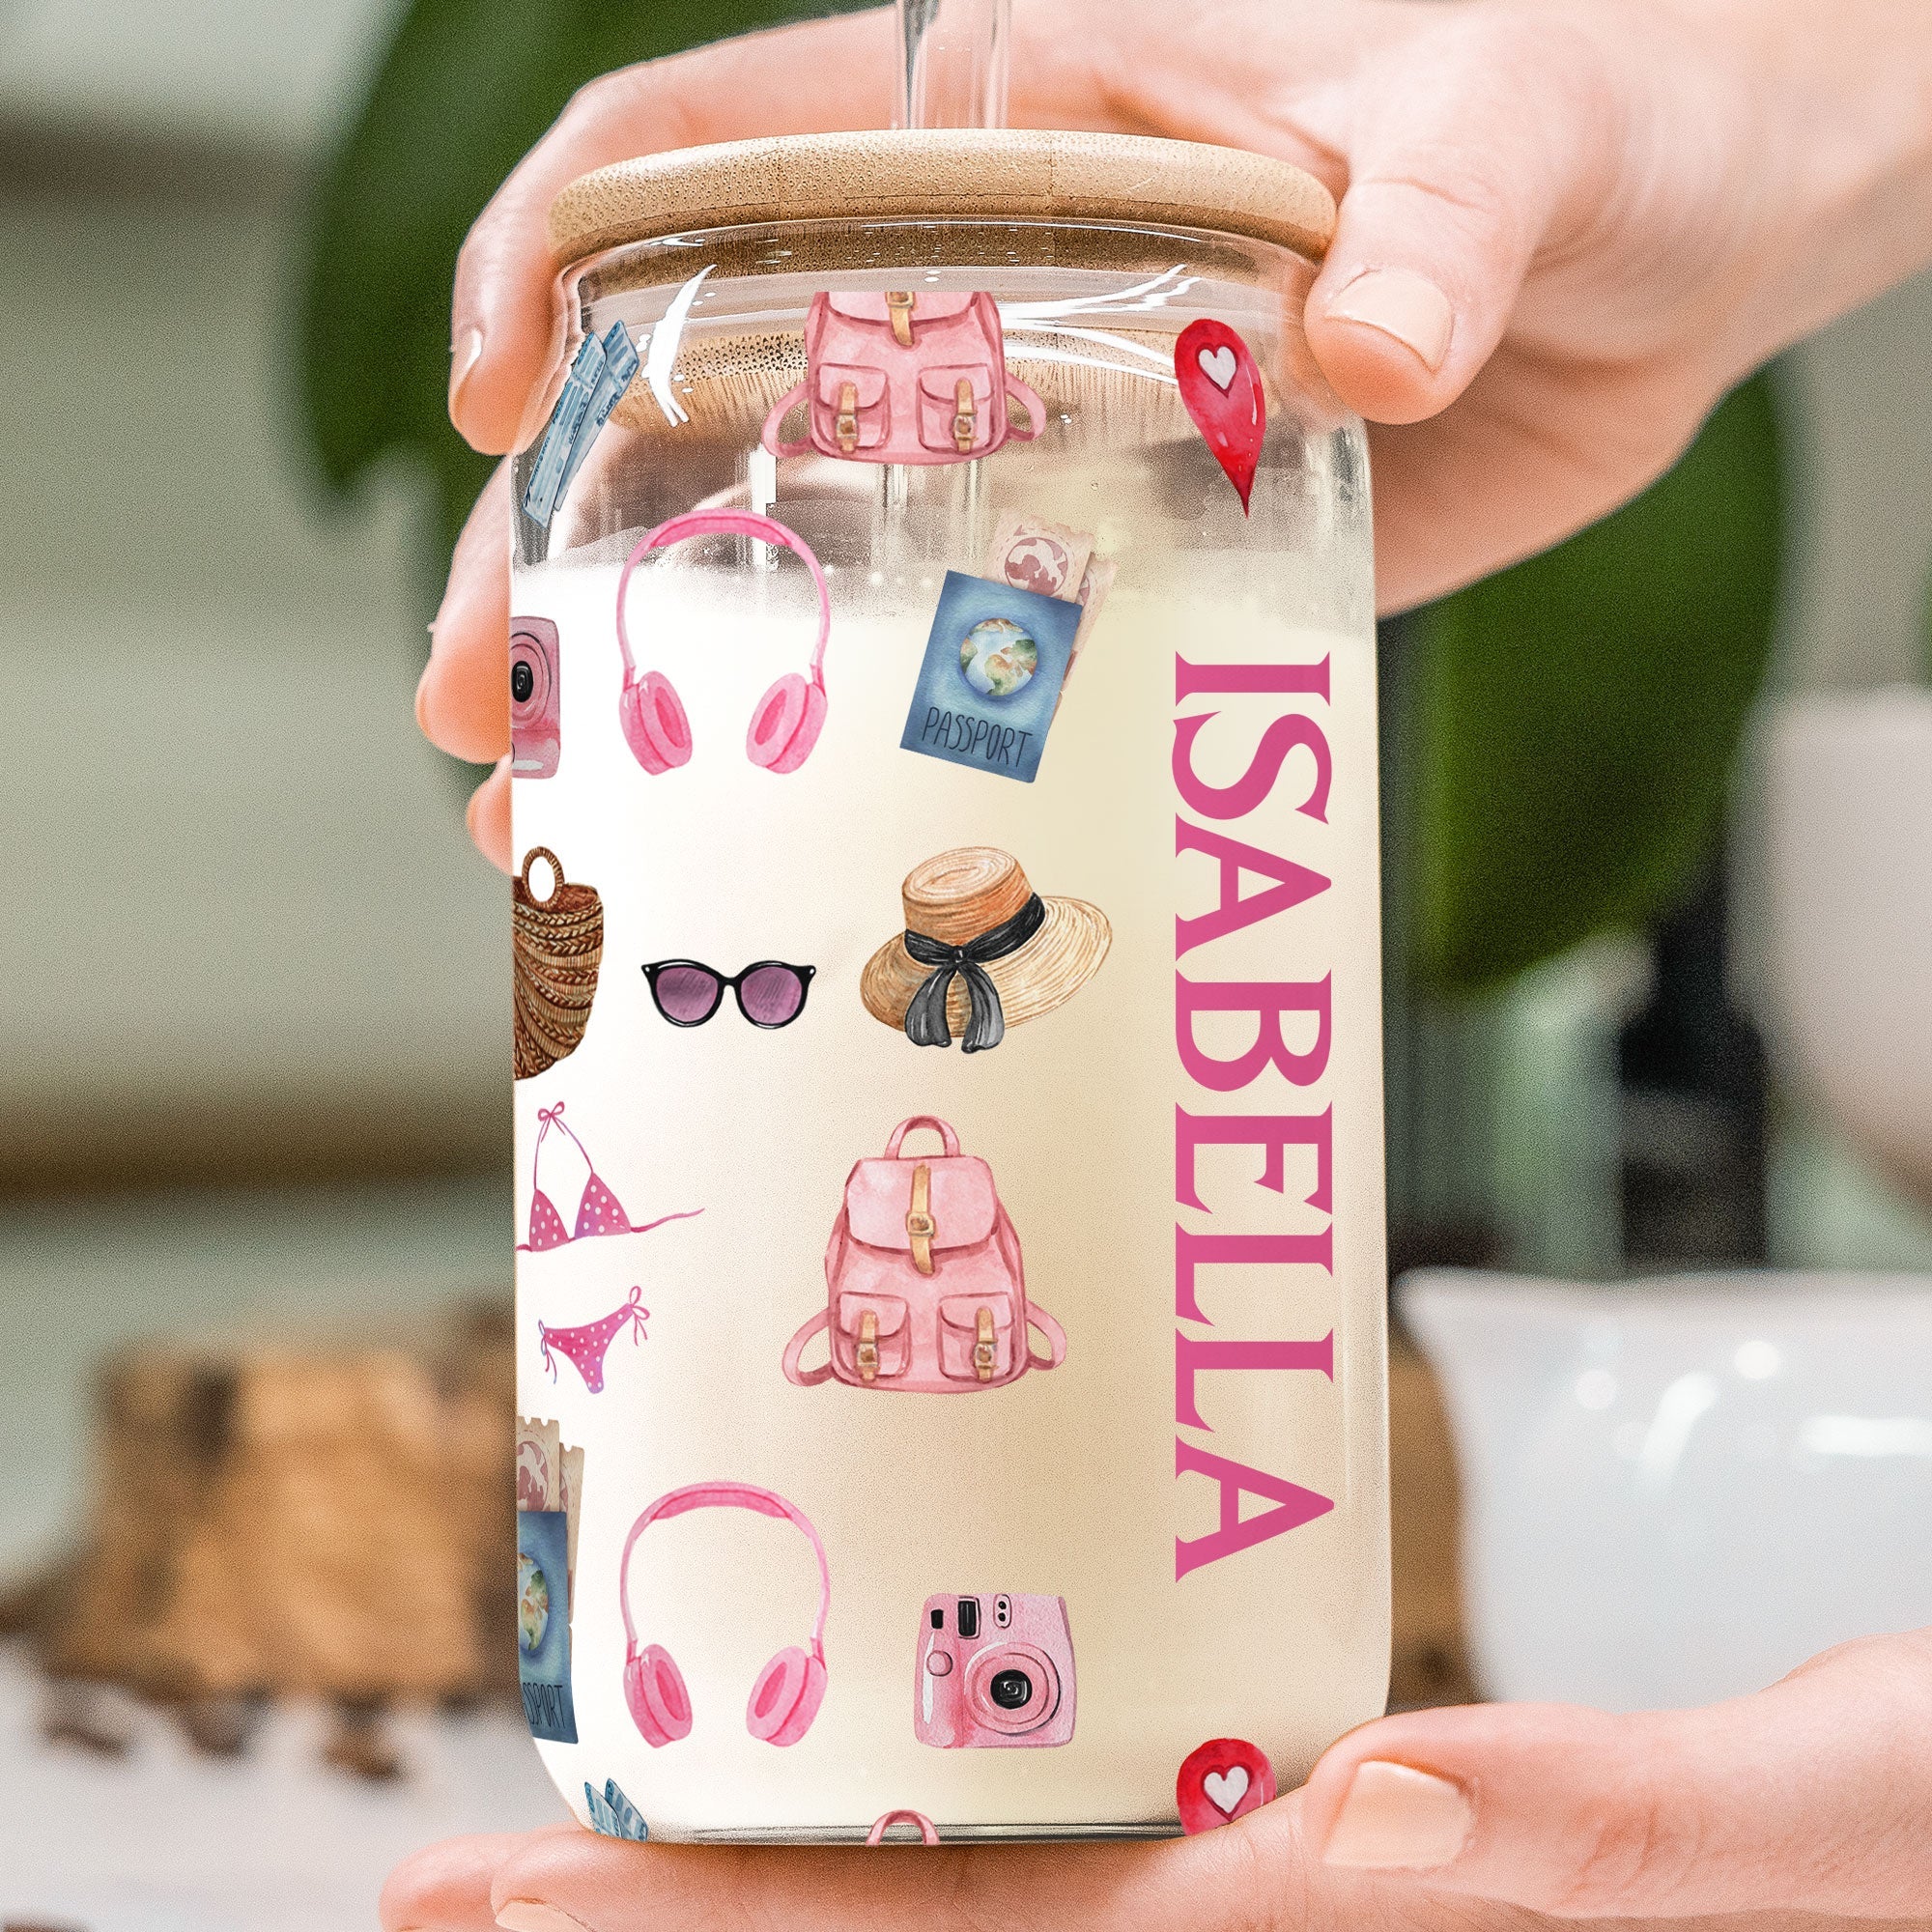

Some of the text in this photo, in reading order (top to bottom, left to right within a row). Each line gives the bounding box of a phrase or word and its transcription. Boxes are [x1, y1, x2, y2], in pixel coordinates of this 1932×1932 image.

[922, 706, 1033, 767] PASSPORT
[1172, 651, 1334, 1582] ISABELLA
[523, 1682, 566, 1729] SSPORT
